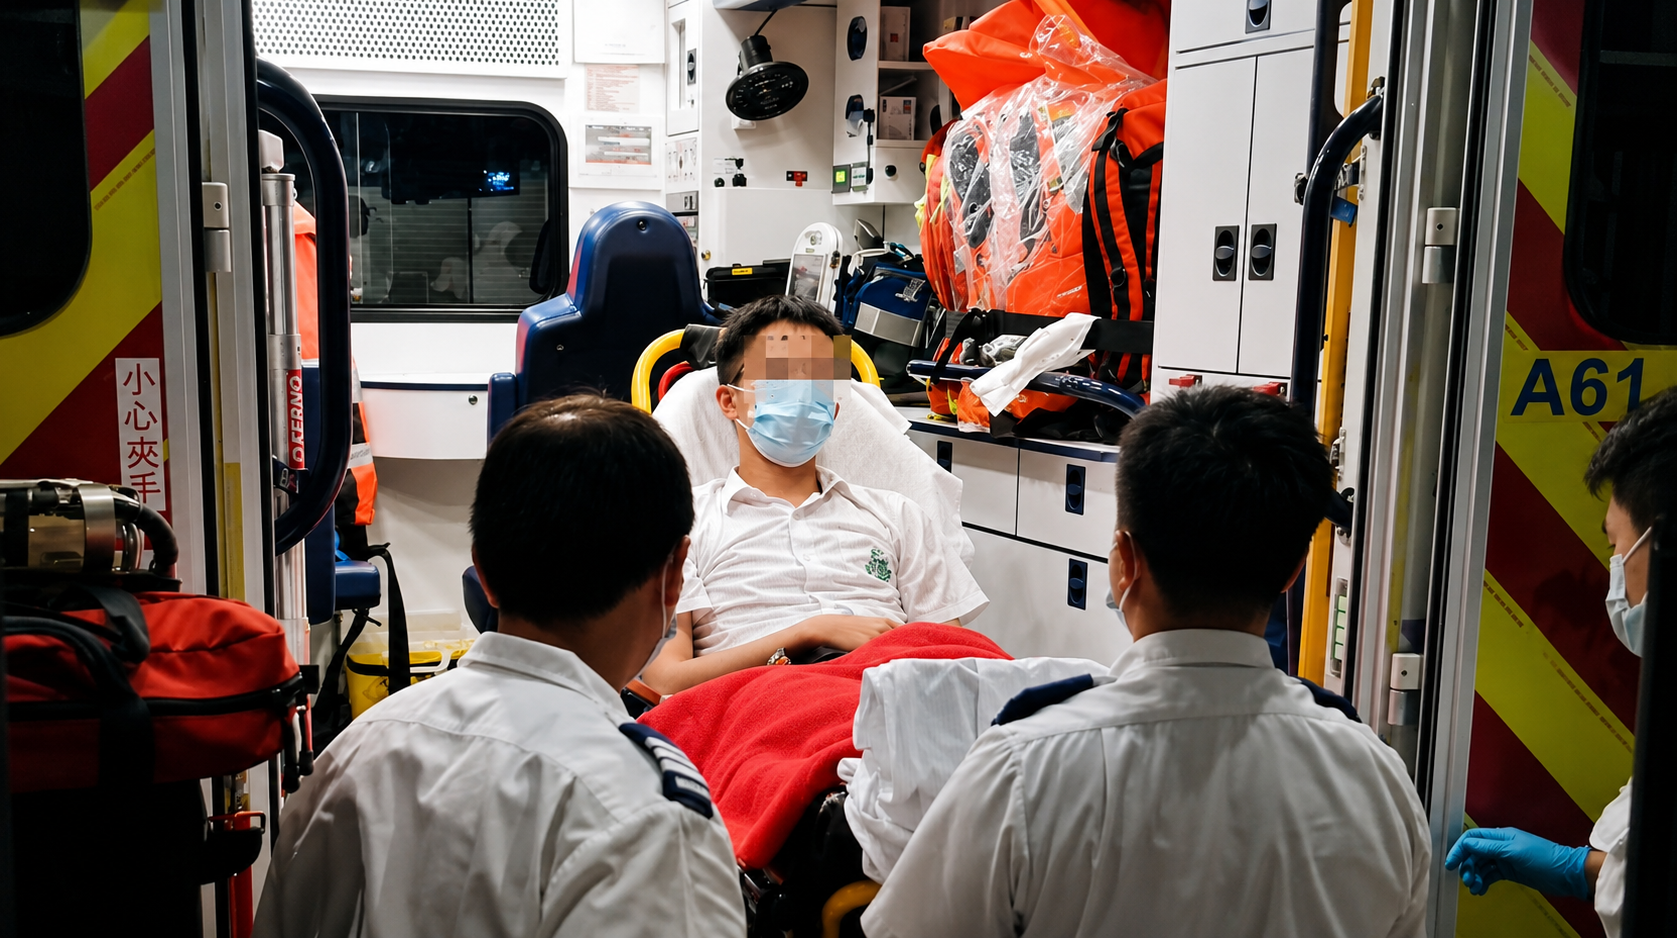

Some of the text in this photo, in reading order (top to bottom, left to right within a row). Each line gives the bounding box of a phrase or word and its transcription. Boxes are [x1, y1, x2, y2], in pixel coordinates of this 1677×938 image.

[123, 363, 161, 503] 小心夾手
[1510, 358, 1644, 416] A61
